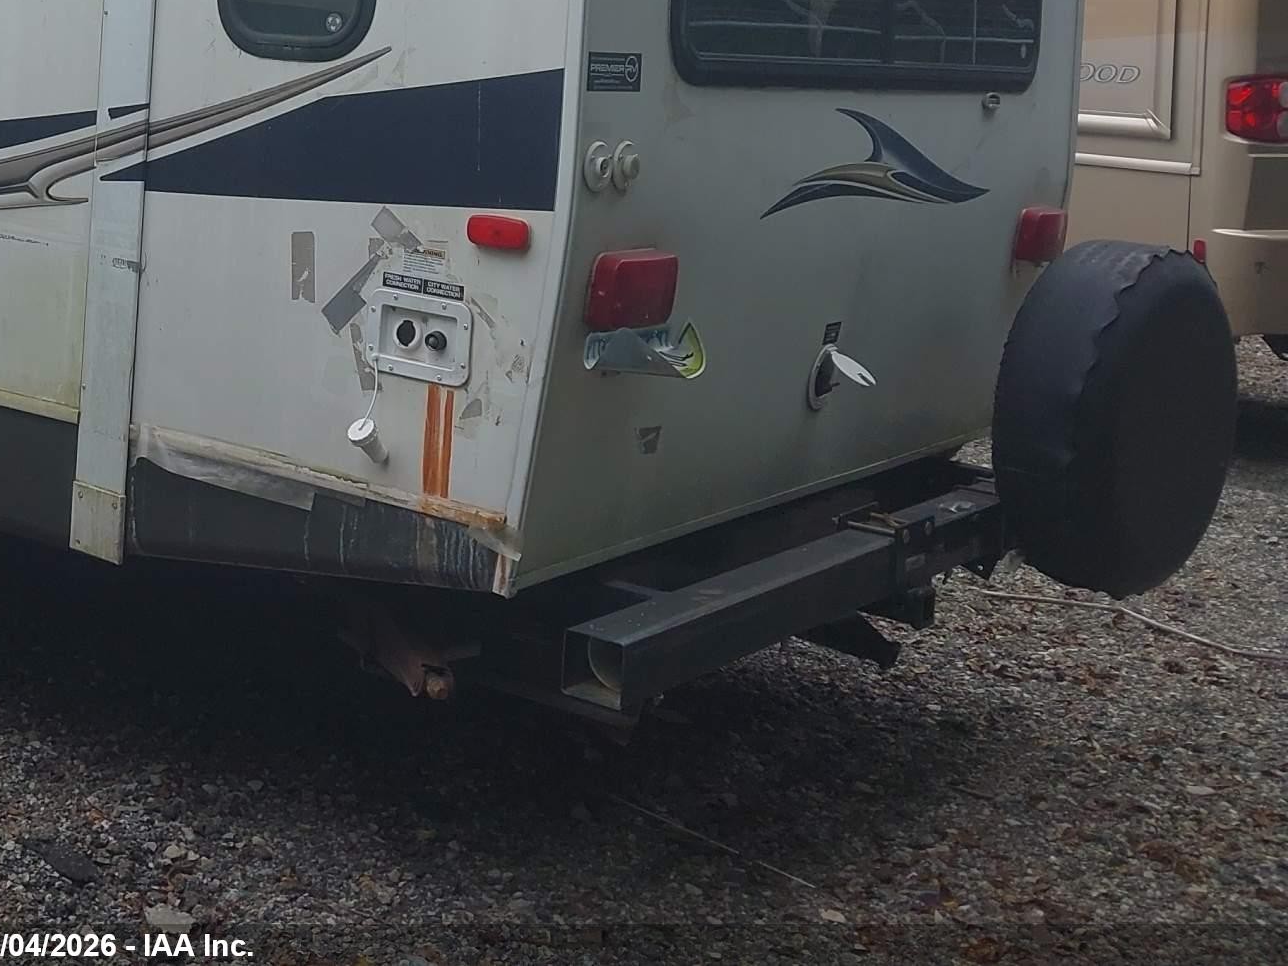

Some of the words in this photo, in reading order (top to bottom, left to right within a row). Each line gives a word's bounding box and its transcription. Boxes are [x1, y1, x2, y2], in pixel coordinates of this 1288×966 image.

[384, 273, 402, 281] FRESH
[403, 276, 422, 285] WATER
[385, 279, 420, 291] CONNECTION
[427, 281, 440, 289] CITY
[440, 283, 460, 292] WATER
[426, 287, 461, 298] CONNECTION
